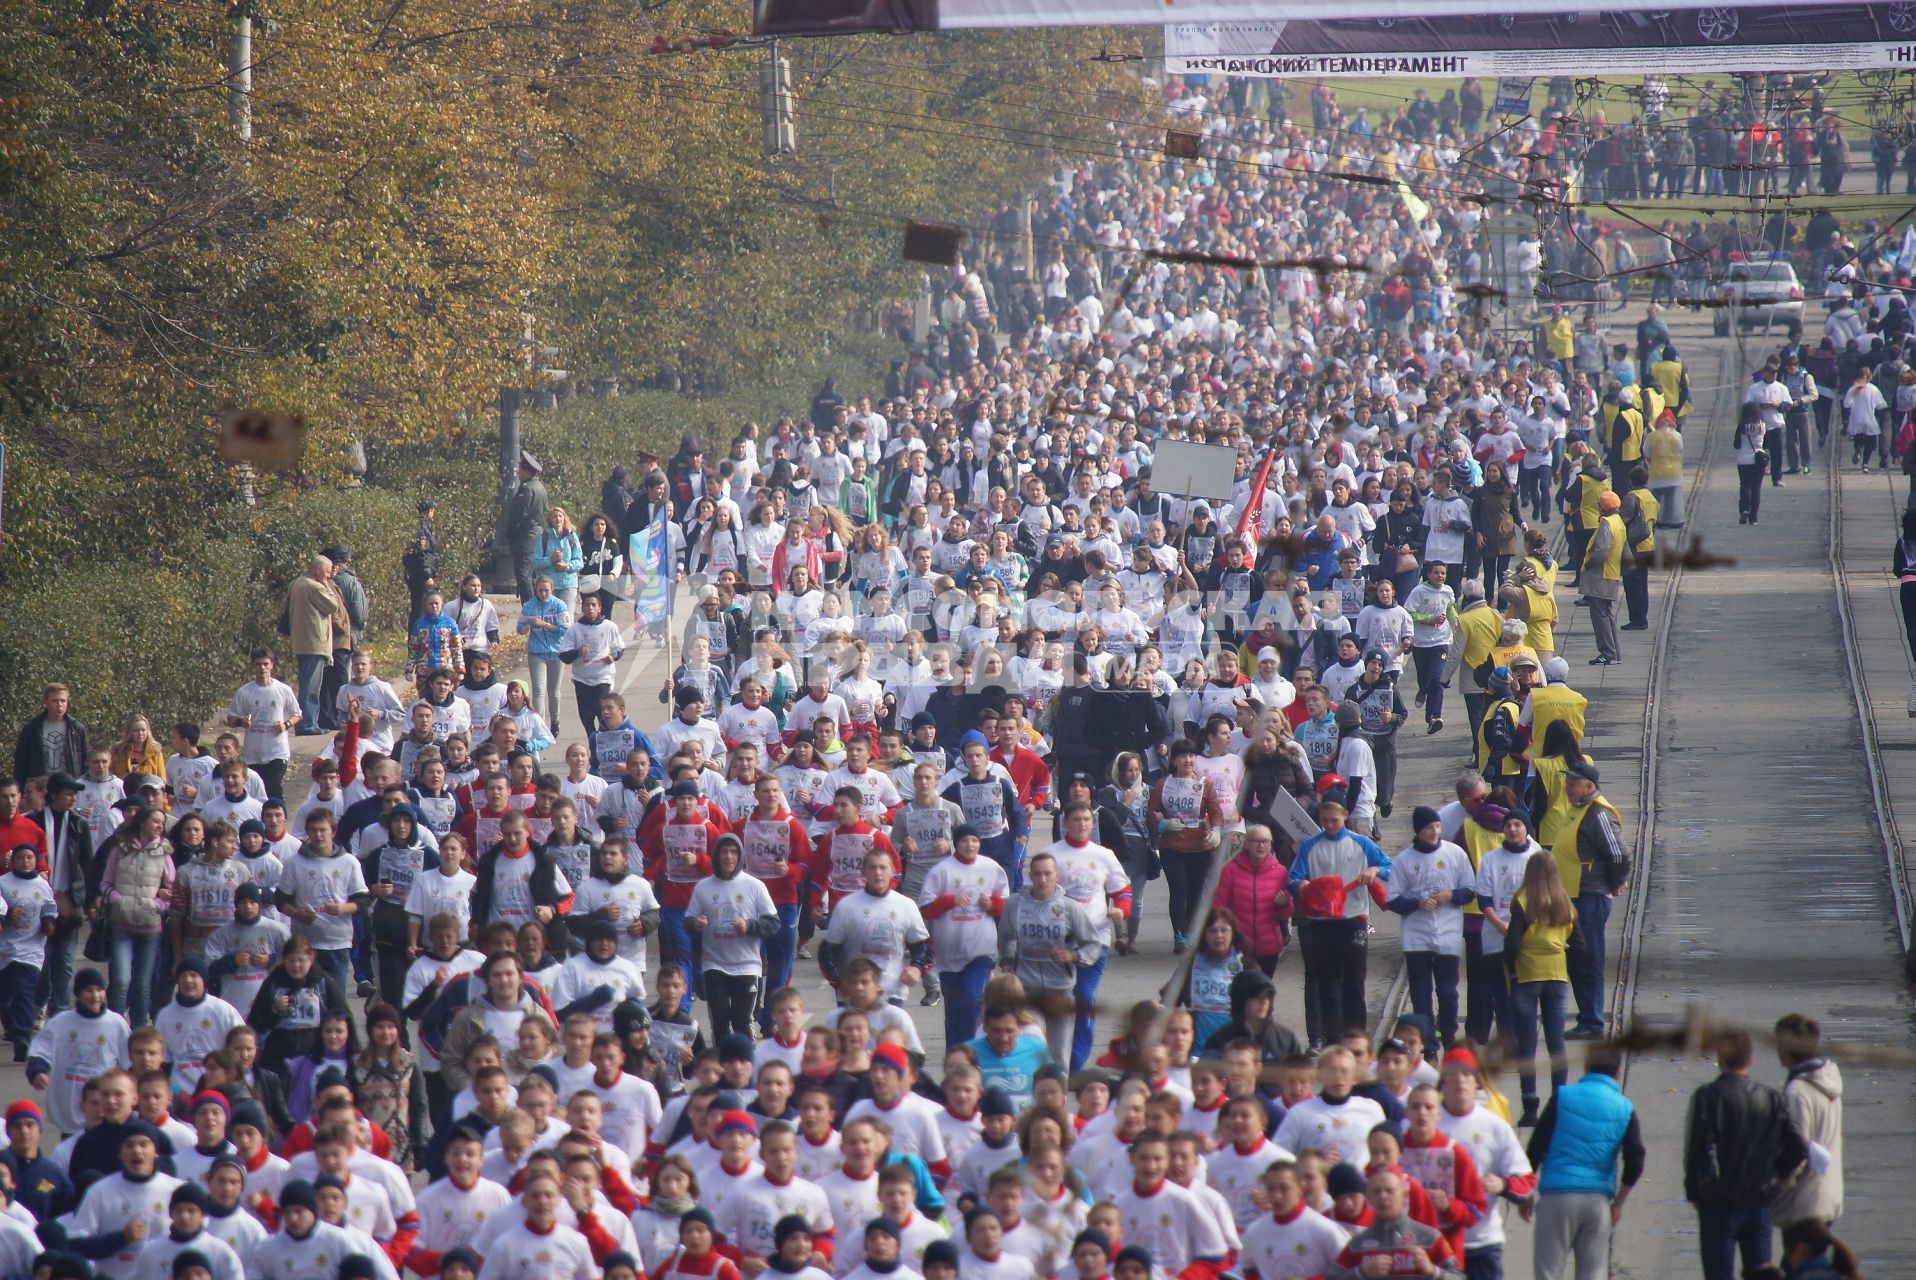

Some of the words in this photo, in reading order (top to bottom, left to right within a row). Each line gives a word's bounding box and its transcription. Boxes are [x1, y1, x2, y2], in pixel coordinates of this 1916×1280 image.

[1185, 56, 1313, 74] ИСПАНСКИЙ
[1317, 55, 1470, 74] ТЕМПЕРАМЕНТ
[1309, 741, 1333, 754] 1818
[602, 748, 628, 763] 1830
[1167, 796, 1195, 810] 9408
[967, 804, 1001, 820] 15432
[1020, 922, 1061, 940] 13810
